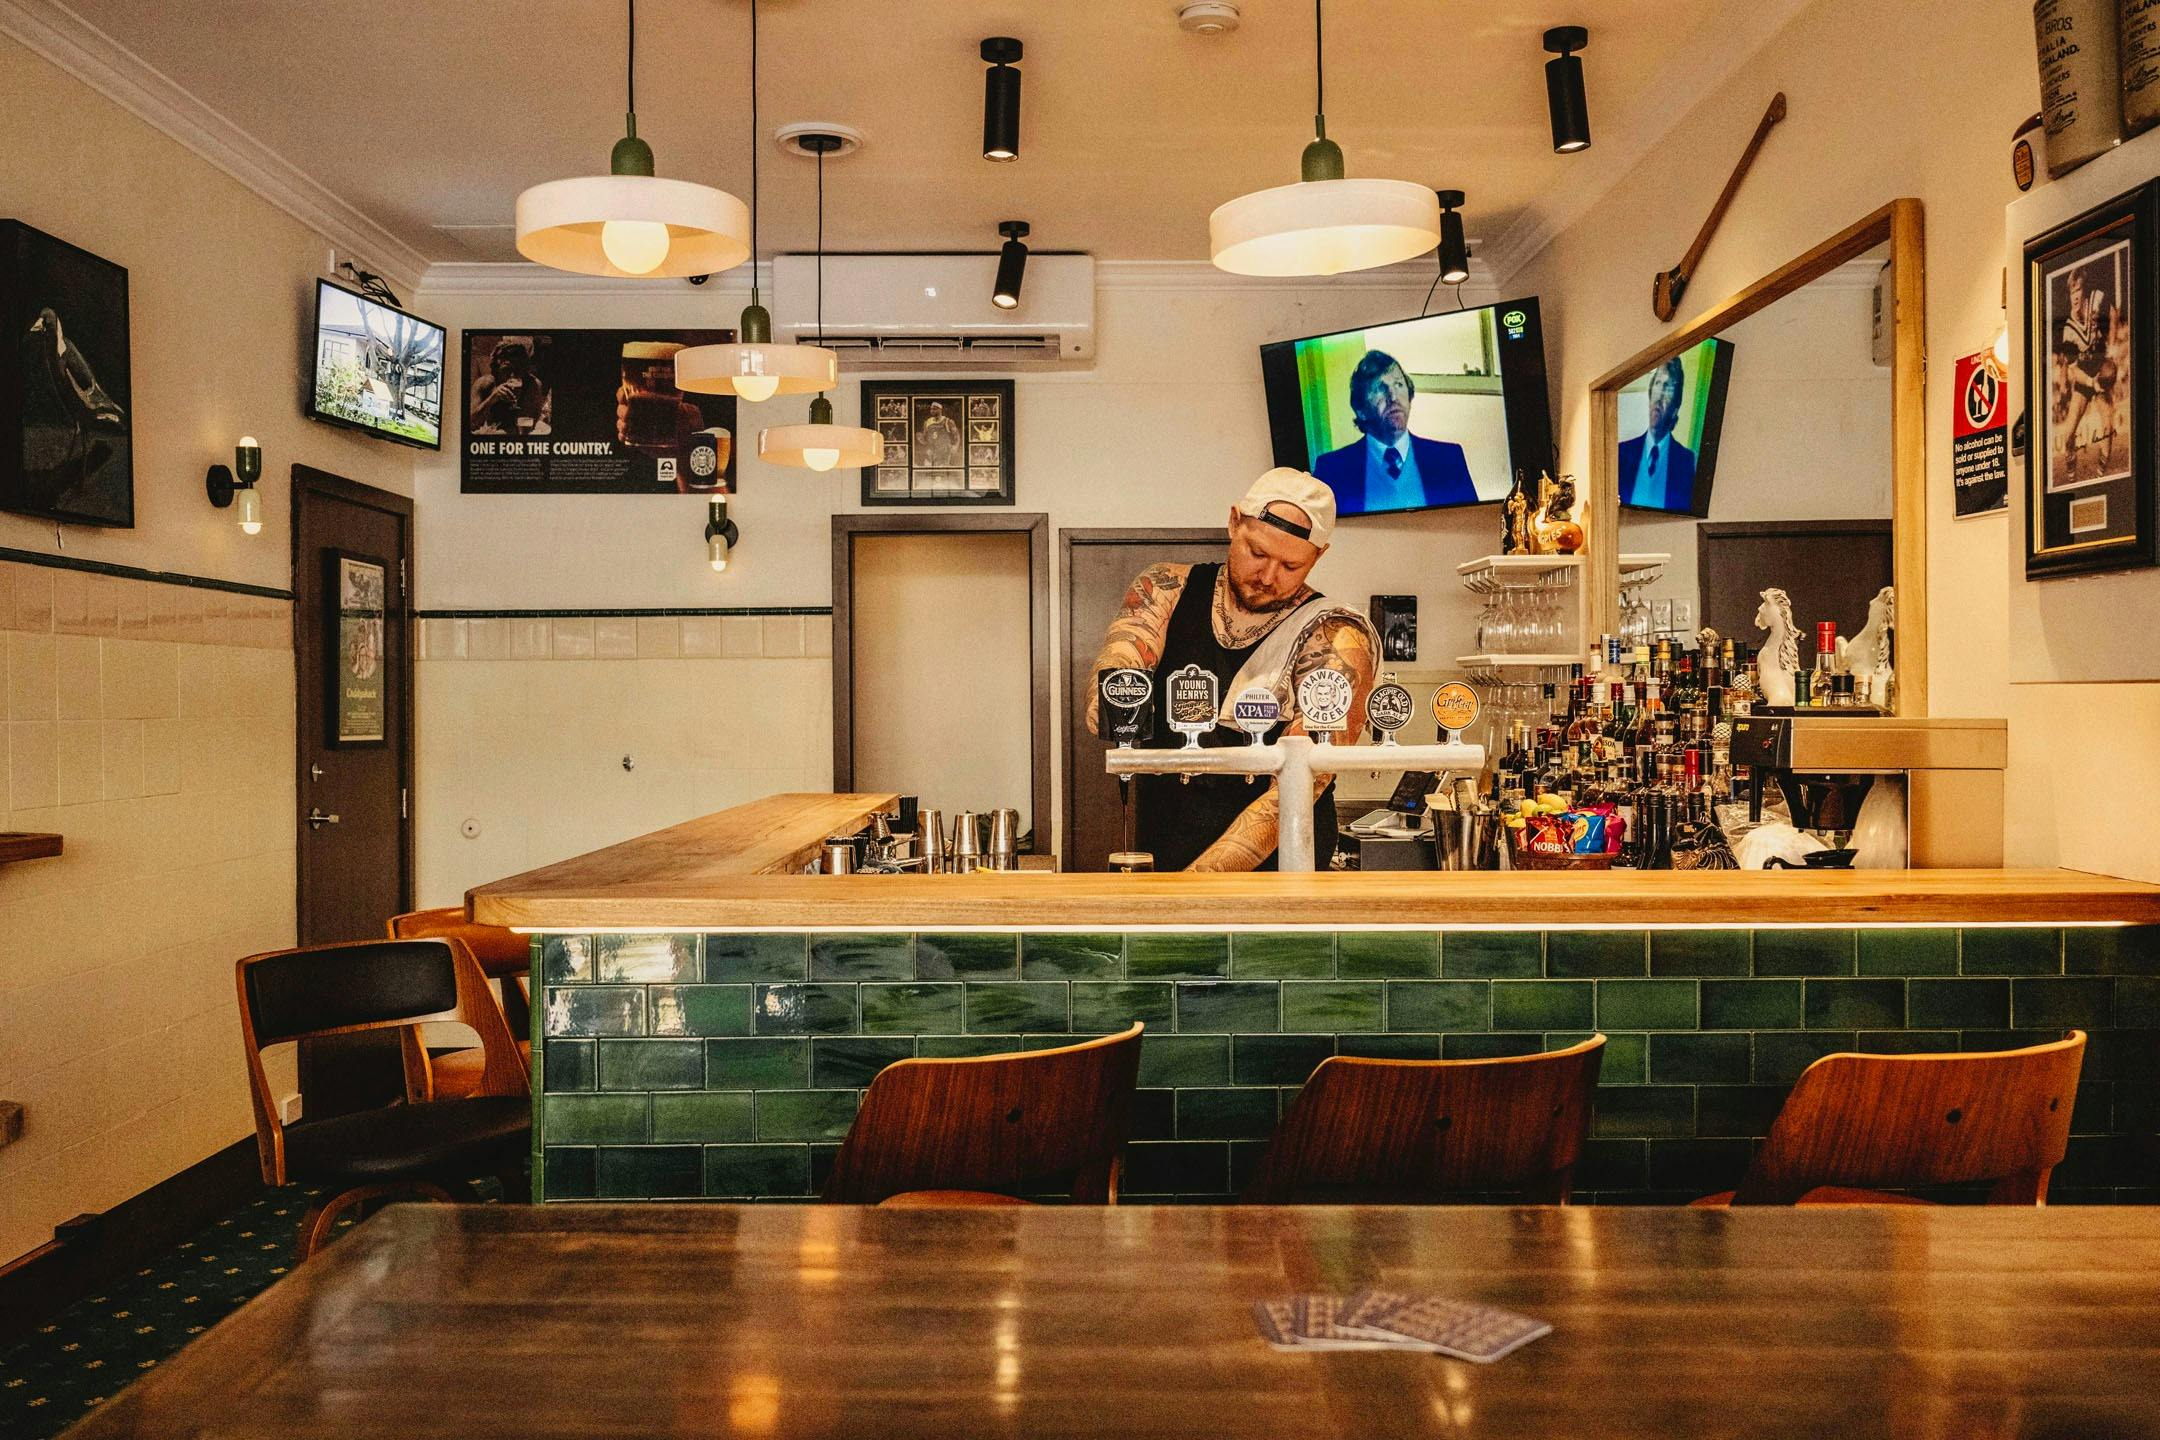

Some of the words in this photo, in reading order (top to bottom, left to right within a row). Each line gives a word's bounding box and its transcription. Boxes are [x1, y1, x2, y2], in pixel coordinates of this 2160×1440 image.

[1506, 314, 1522, 325] FOX
[470, 441, 495, 455] ONE
[499, 441, 524, 455] FOR
[527, 441, 550, 455] THE
[552, 441, 613, 455] COUNTRY.
[1955, 443, 1963, 453] No
[1963, 438, 1984, 451] alcohol
[1984, 436, 1994, 446] can
[1995, 434, 2002, 443] be
[1955, 453, 1967, 464] sold
[1967, 453, 1974, 461] or
[1974, 446, 1997, 461] supplied
[1997, 445, 2004, 454] to
[1955, 465, 1974, 477] anyone
[1975, 460, 1991, 471] under
[1955, 477, 1964, 487] It's
[1964, 473, 1984, 487] against
[1984, 471, 1994, 481] the
[1179, 679, 1207, 690] YOUNG
[1302, 671, 1348, 690] HAWKE'S
[1108, 686, 1147, 696] GUINNESS
[1176, 690, 1209, 700] HENRYS
[1237, 704, 1264, 717] XPA
[1306, 707, 1344, 721] LAGER
